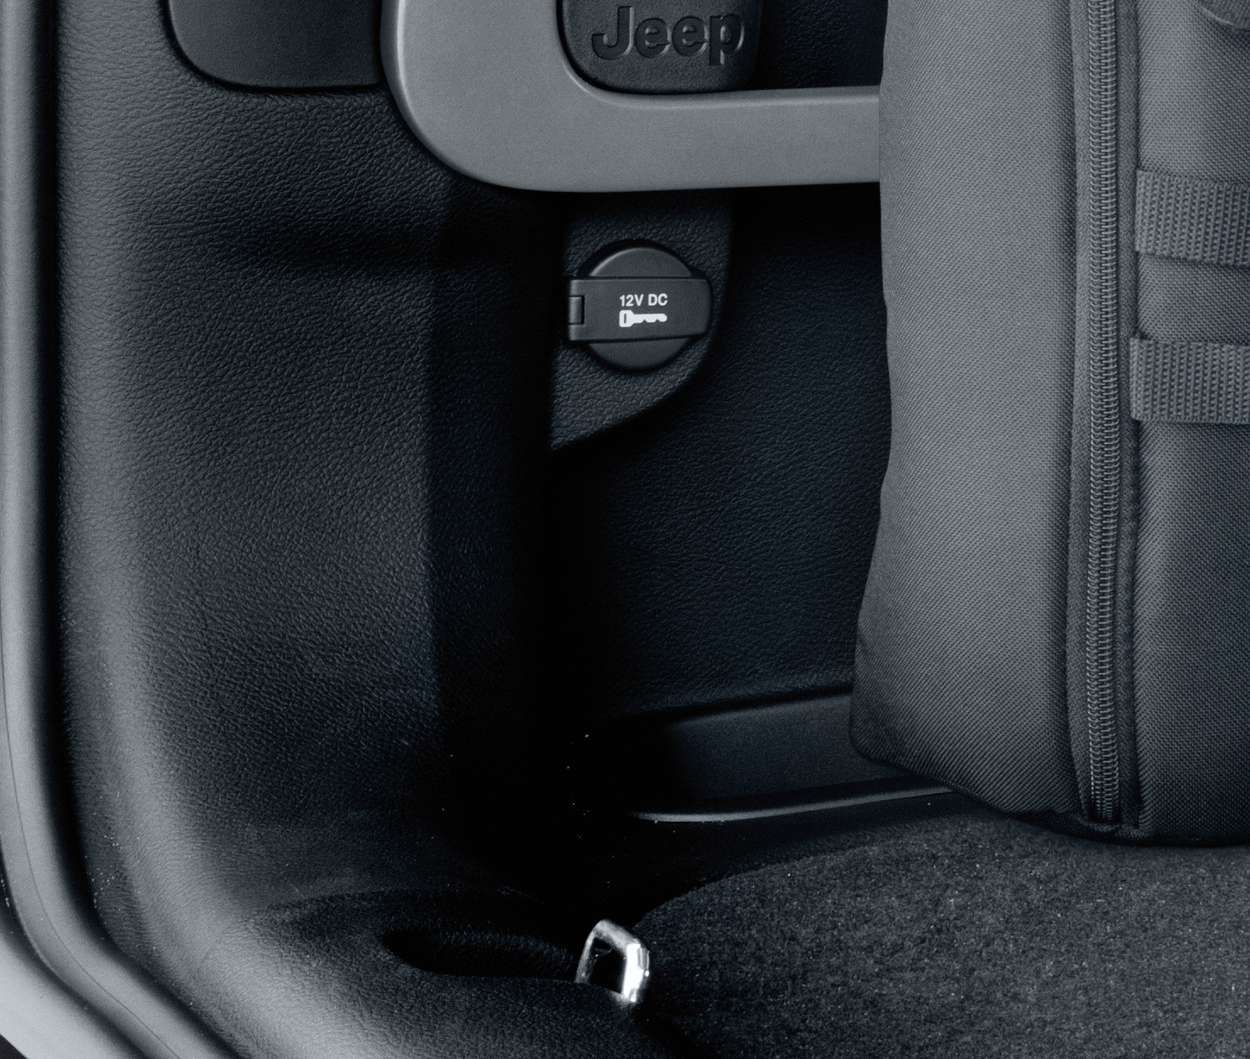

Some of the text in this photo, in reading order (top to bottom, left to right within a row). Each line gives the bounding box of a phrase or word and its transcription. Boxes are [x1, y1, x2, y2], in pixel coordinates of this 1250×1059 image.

[591, 5, 745, 66] Jeep
[619, 293, 668, 307] 12V DC
